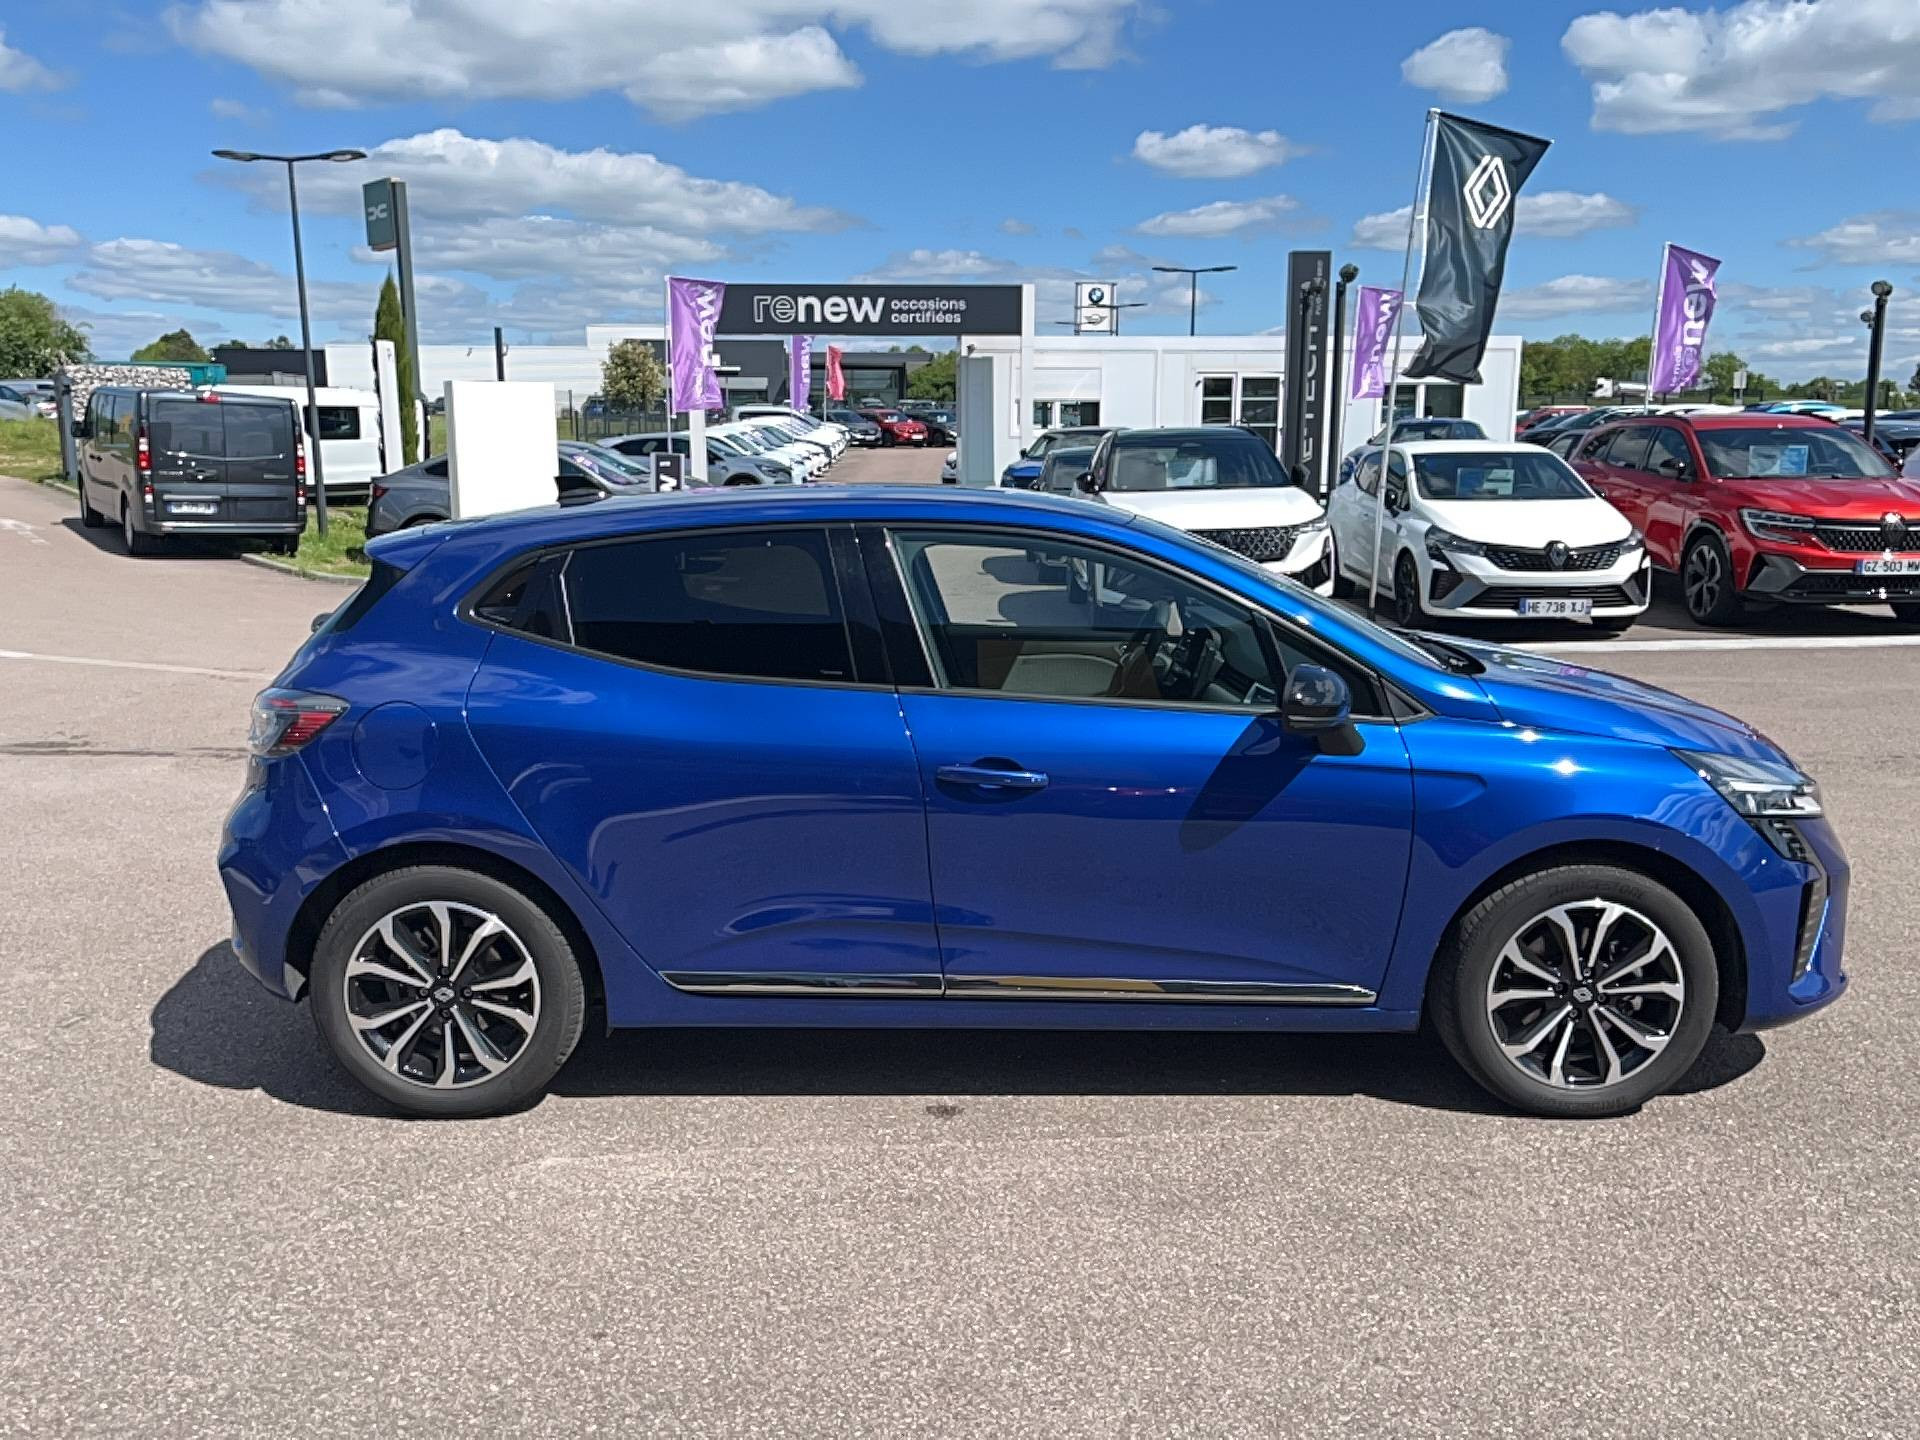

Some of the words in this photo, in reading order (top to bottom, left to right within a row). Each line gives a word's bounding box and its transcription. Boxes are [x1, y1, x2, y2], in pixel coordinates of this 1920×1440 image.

[753, 295, 885, 323] renew
[891, 297, 967, 311] occasions
[891, 310, 961, 323] certifiées
